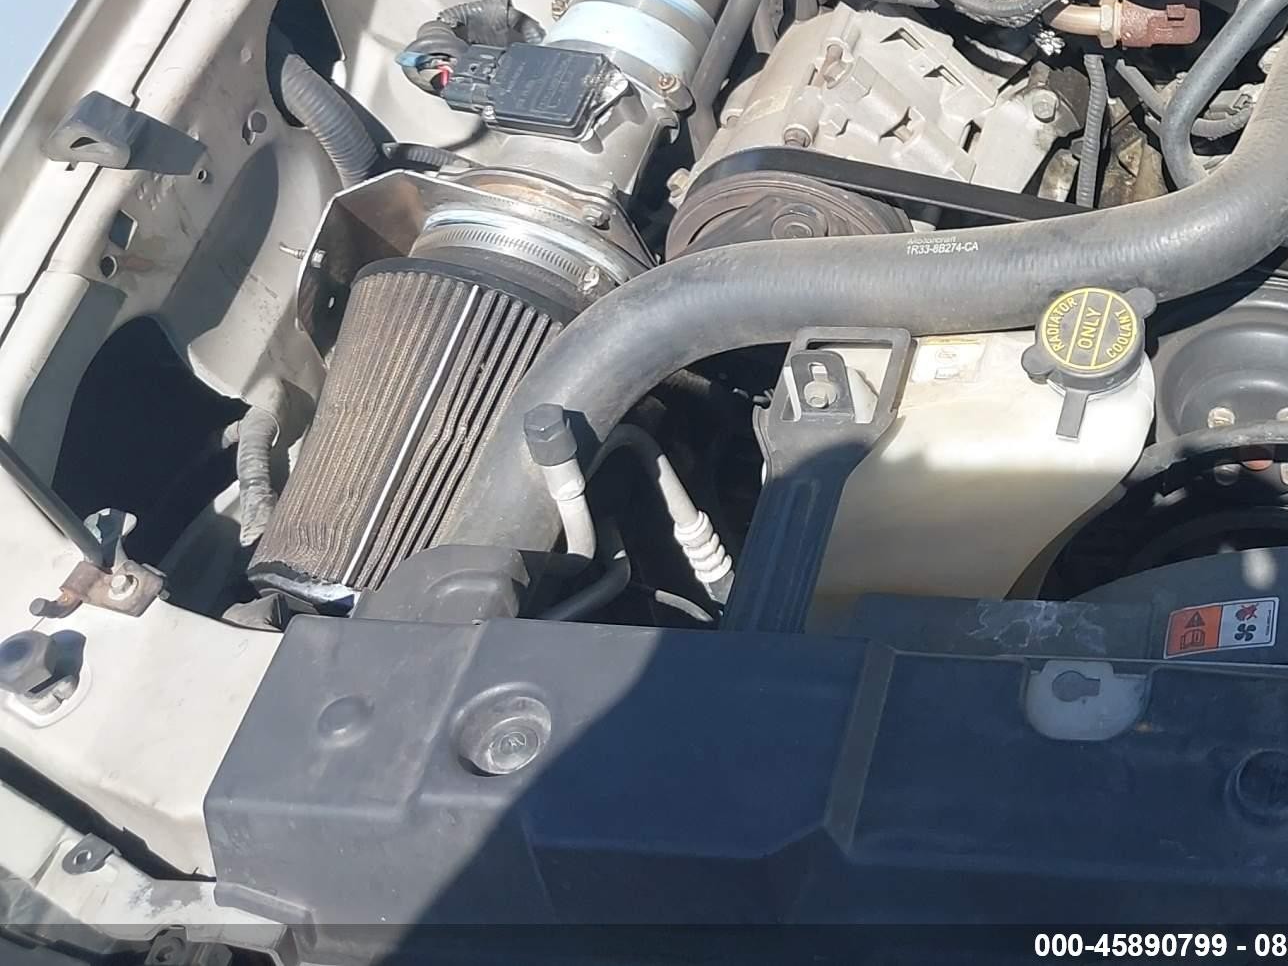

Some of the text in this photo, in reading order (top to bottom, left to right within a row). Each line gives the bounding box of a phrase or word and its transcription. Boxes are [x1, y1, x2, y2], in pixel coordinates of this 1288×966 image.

[1046, 296, 1078, 352] RADIATOR
[1077, 307, 1102, 349] ONLY
[1106, 308, 1134, 358] COOLANT
